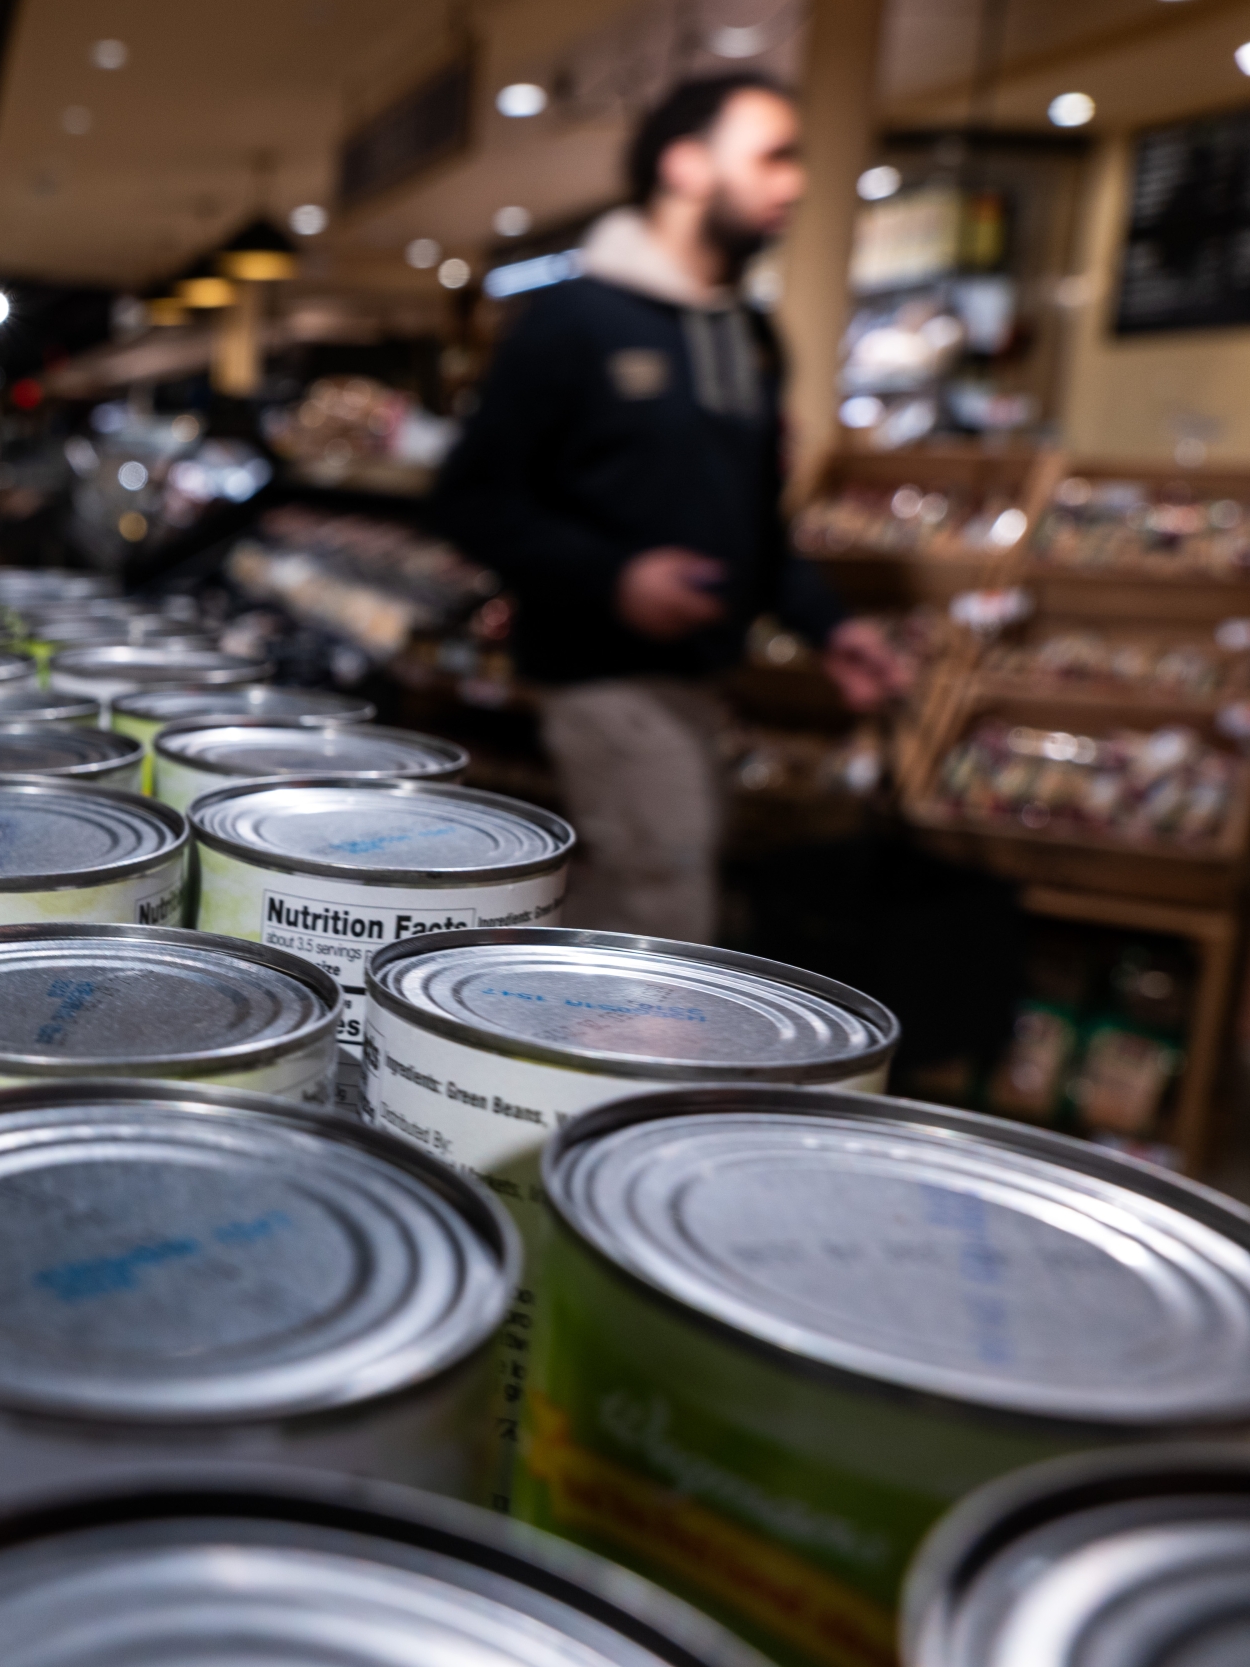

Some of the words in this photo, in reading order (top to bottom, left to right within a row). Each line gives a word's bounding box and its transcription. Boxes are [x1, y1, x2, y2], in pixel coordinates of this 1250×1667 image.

[267, 897, 384, 940] Nutrition
[266, 932, 295, 949] about
[297, 939, 313, 953] 3.5
[316, 944, 362, 962] servings
[446, 1080, 488, 1110] Green
